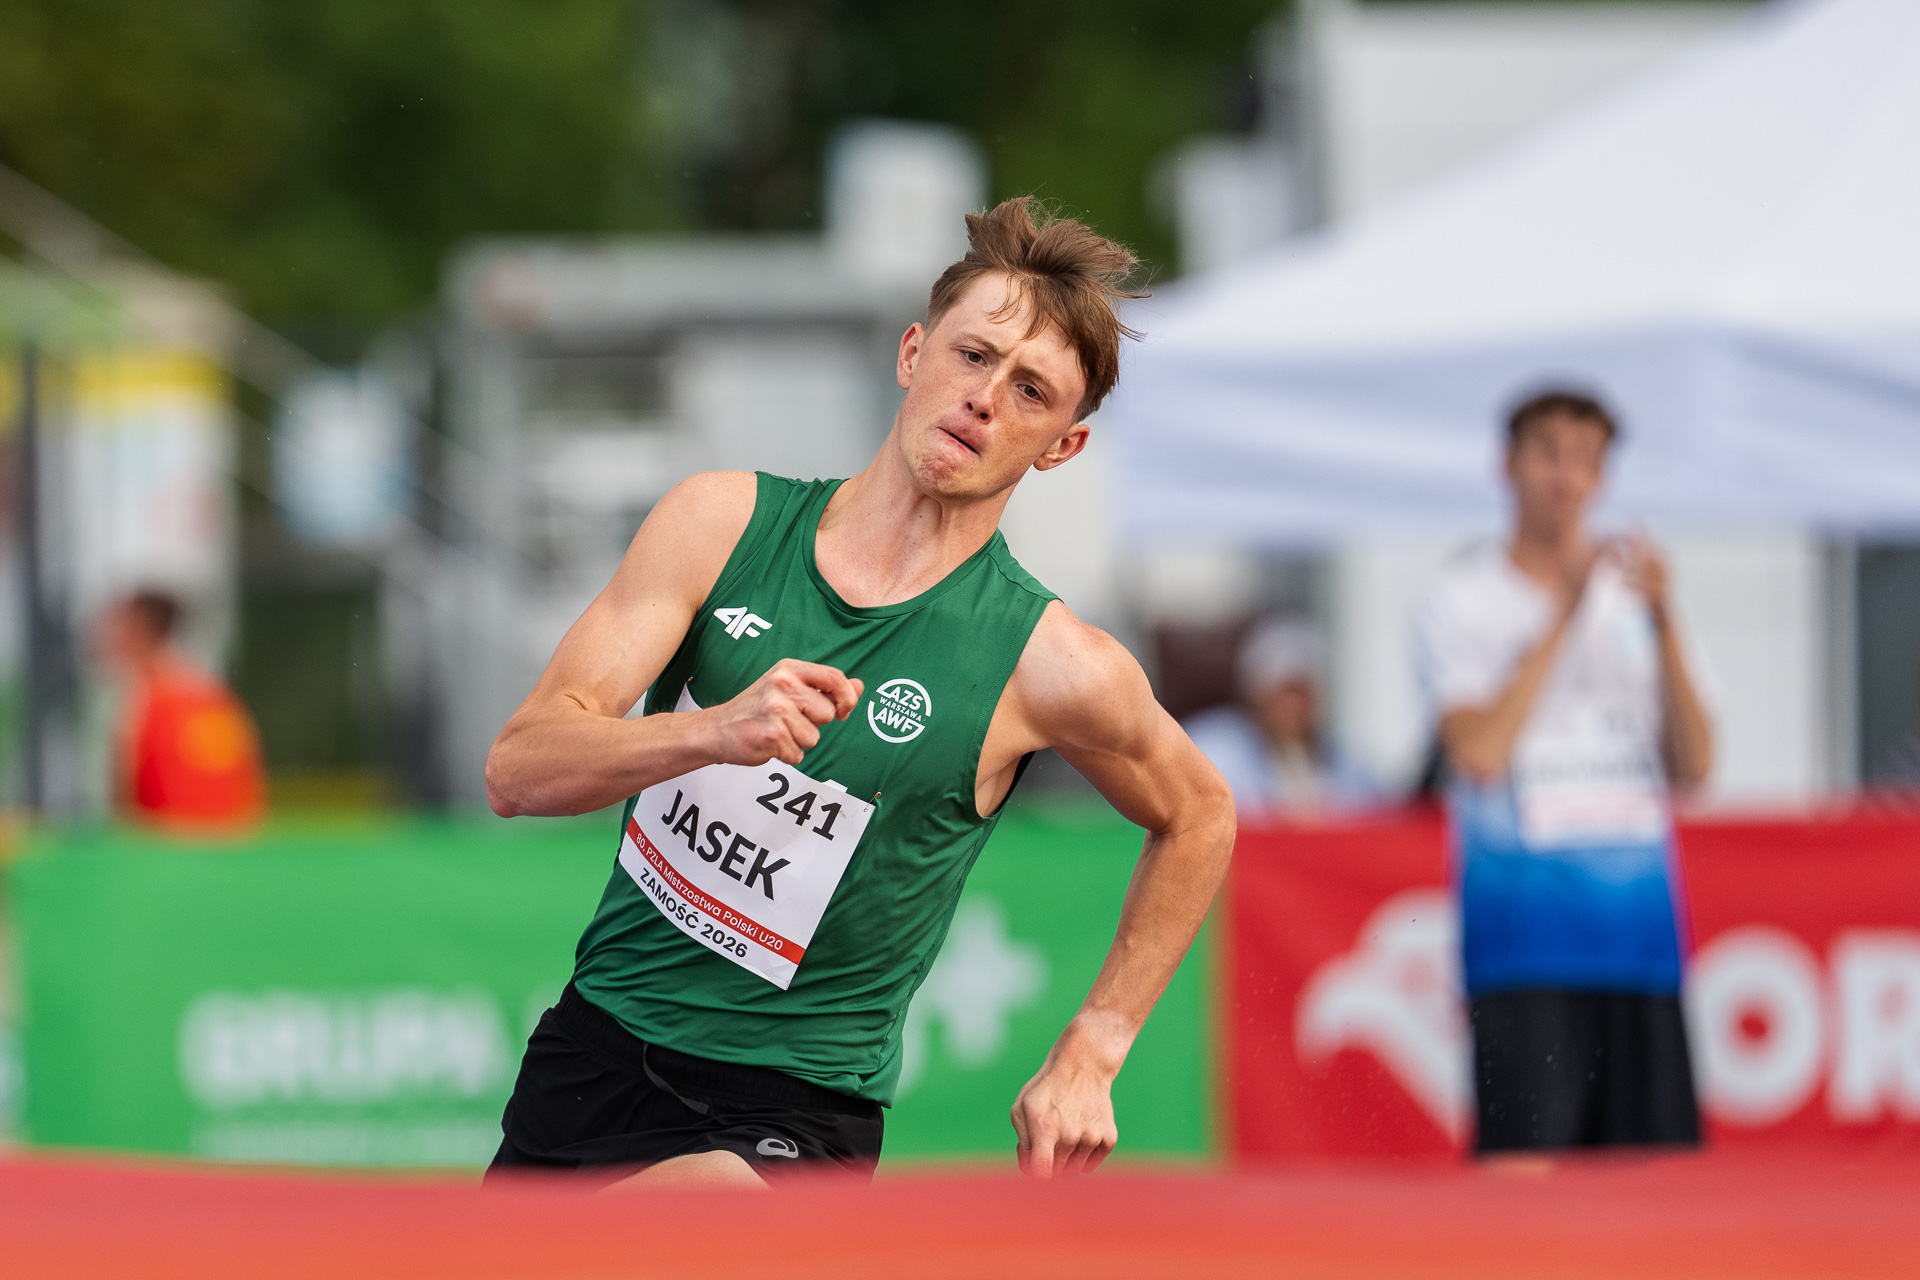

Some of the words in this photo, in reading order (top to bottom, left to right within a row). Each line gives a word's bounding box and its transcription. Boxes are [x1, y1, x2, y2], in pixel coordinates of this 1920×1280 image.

[713, 606, 773, 640] 4F
[873, 707, 922, 733] AWF
[879, 696, 923, 722] WARSZAWA
[886, 686, 923, 711] AZS
[754, 772, 842, 841] 241
[661, 789, 791, 901] JASEK
[635, 832, 646, 853] 80.
[645, 847, 664, 871] PZLA
[663, 866, 721, 916] Mistrzostwa
[722, 910, 759, 937] Polski
[758, 931, 784, 951] U20
[640, 867, 700, 929] ZAMOŚĆ
[700, 923, 748, 958] 2026
